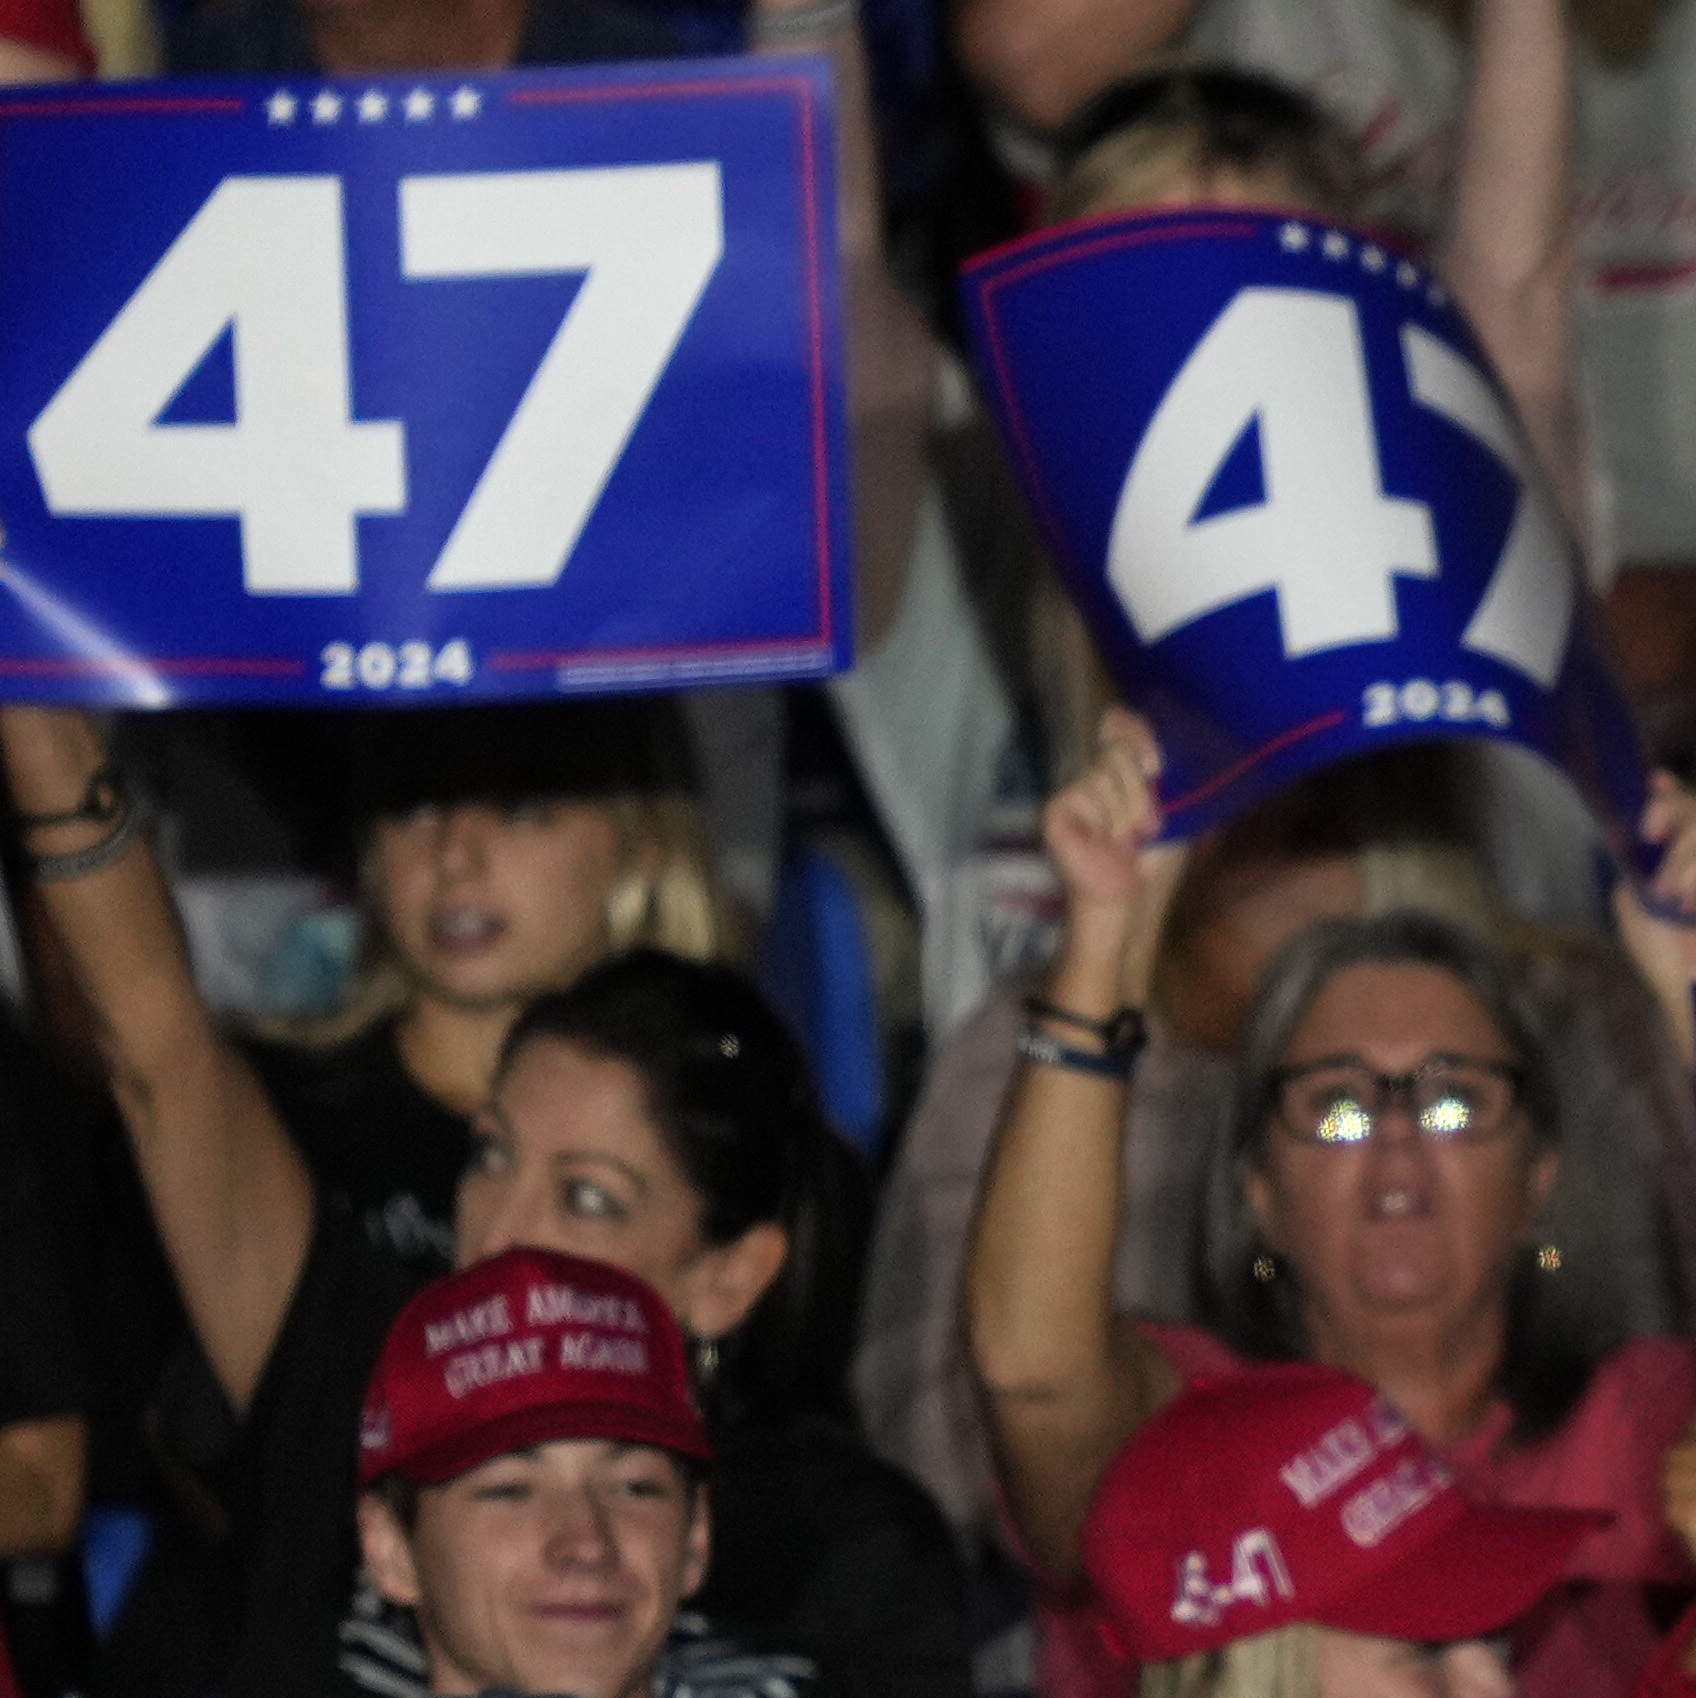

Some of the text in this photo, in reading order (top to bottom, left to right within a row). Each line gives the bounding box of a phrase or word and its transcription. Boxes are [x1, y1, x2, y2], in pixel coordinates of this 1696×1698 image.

[28, 162, 725, 596] 47
[1105, 285, 1576, 690] 47
[321, 641, 474, 688] 2024
[1362, 682, 1509, 728] 2024
[424, 1282, 649, 1358] MAKE AMERICA
[444, 1331, 648, 1400] GREAT AGAIN
